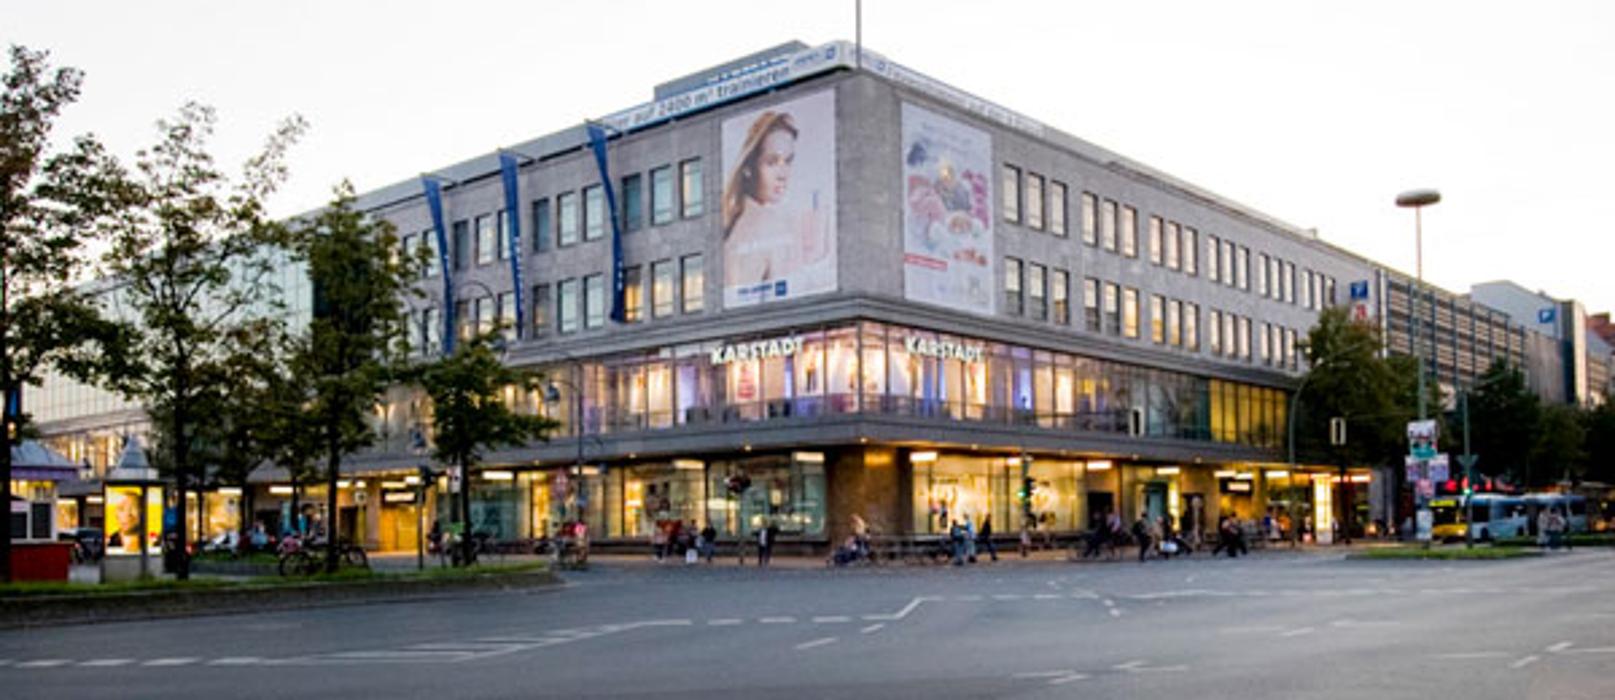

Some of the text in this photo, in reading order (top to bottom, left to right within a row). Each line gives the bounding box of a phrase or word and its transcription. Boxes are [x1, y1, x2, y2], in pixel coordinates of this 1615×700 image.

[658, 96, 692, 117] 2400
[717, 66, 789, 97] trainieren
[710, 336, 806, 365] KARSTADT
[904, 336, 985, 361] KARSTADT
